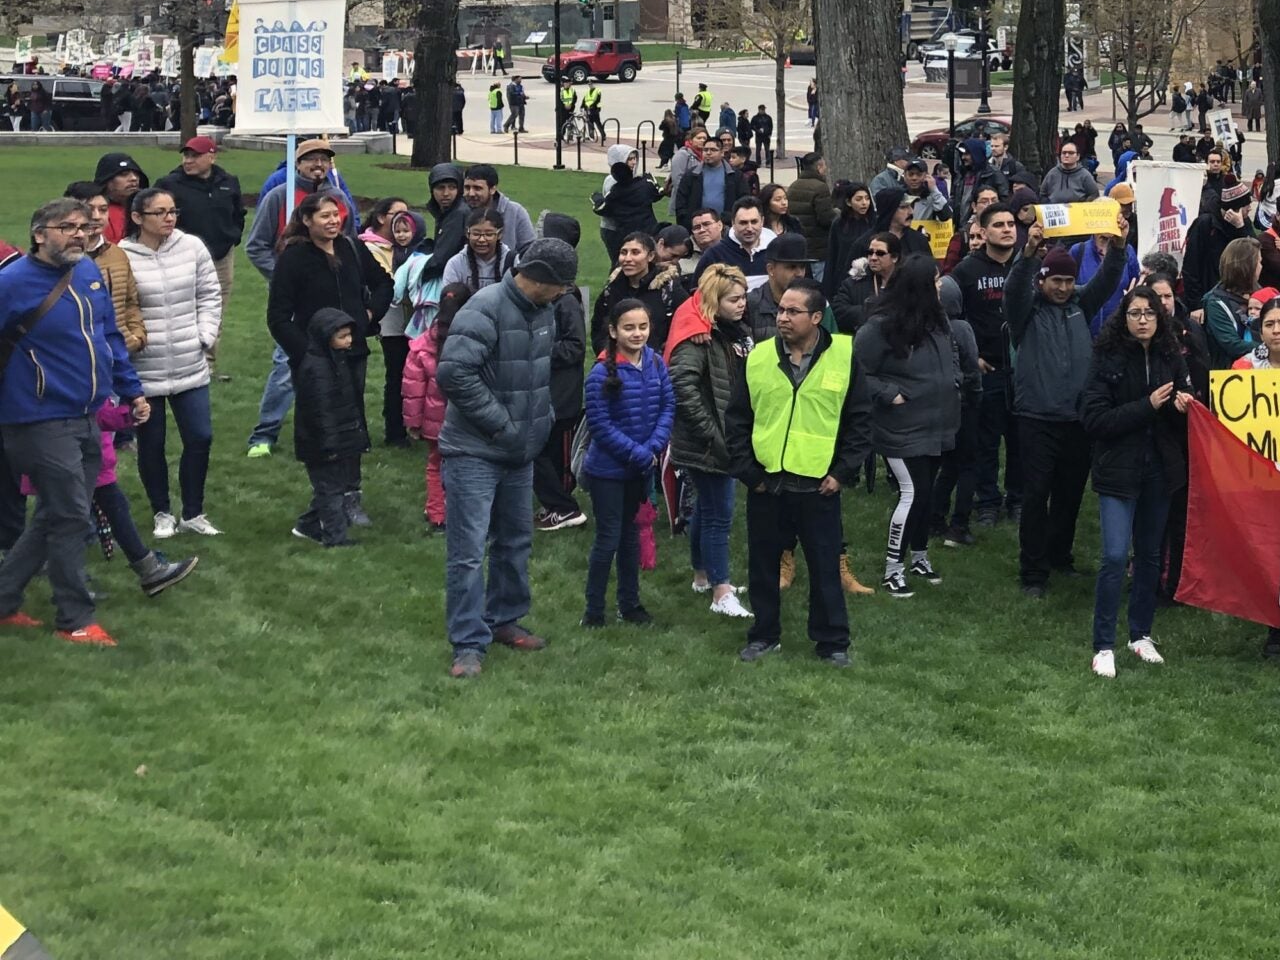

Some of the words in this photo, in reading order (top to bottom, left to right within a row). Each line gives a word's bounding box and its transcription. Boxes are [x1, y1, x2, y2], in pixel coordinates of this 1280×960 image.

[256, 35, 322, 54] CLASS
[256, 58, 322, 78] ROOMS
[255, 88, 320, 112] CAGES
[890, 522, 903, 547] PINK
